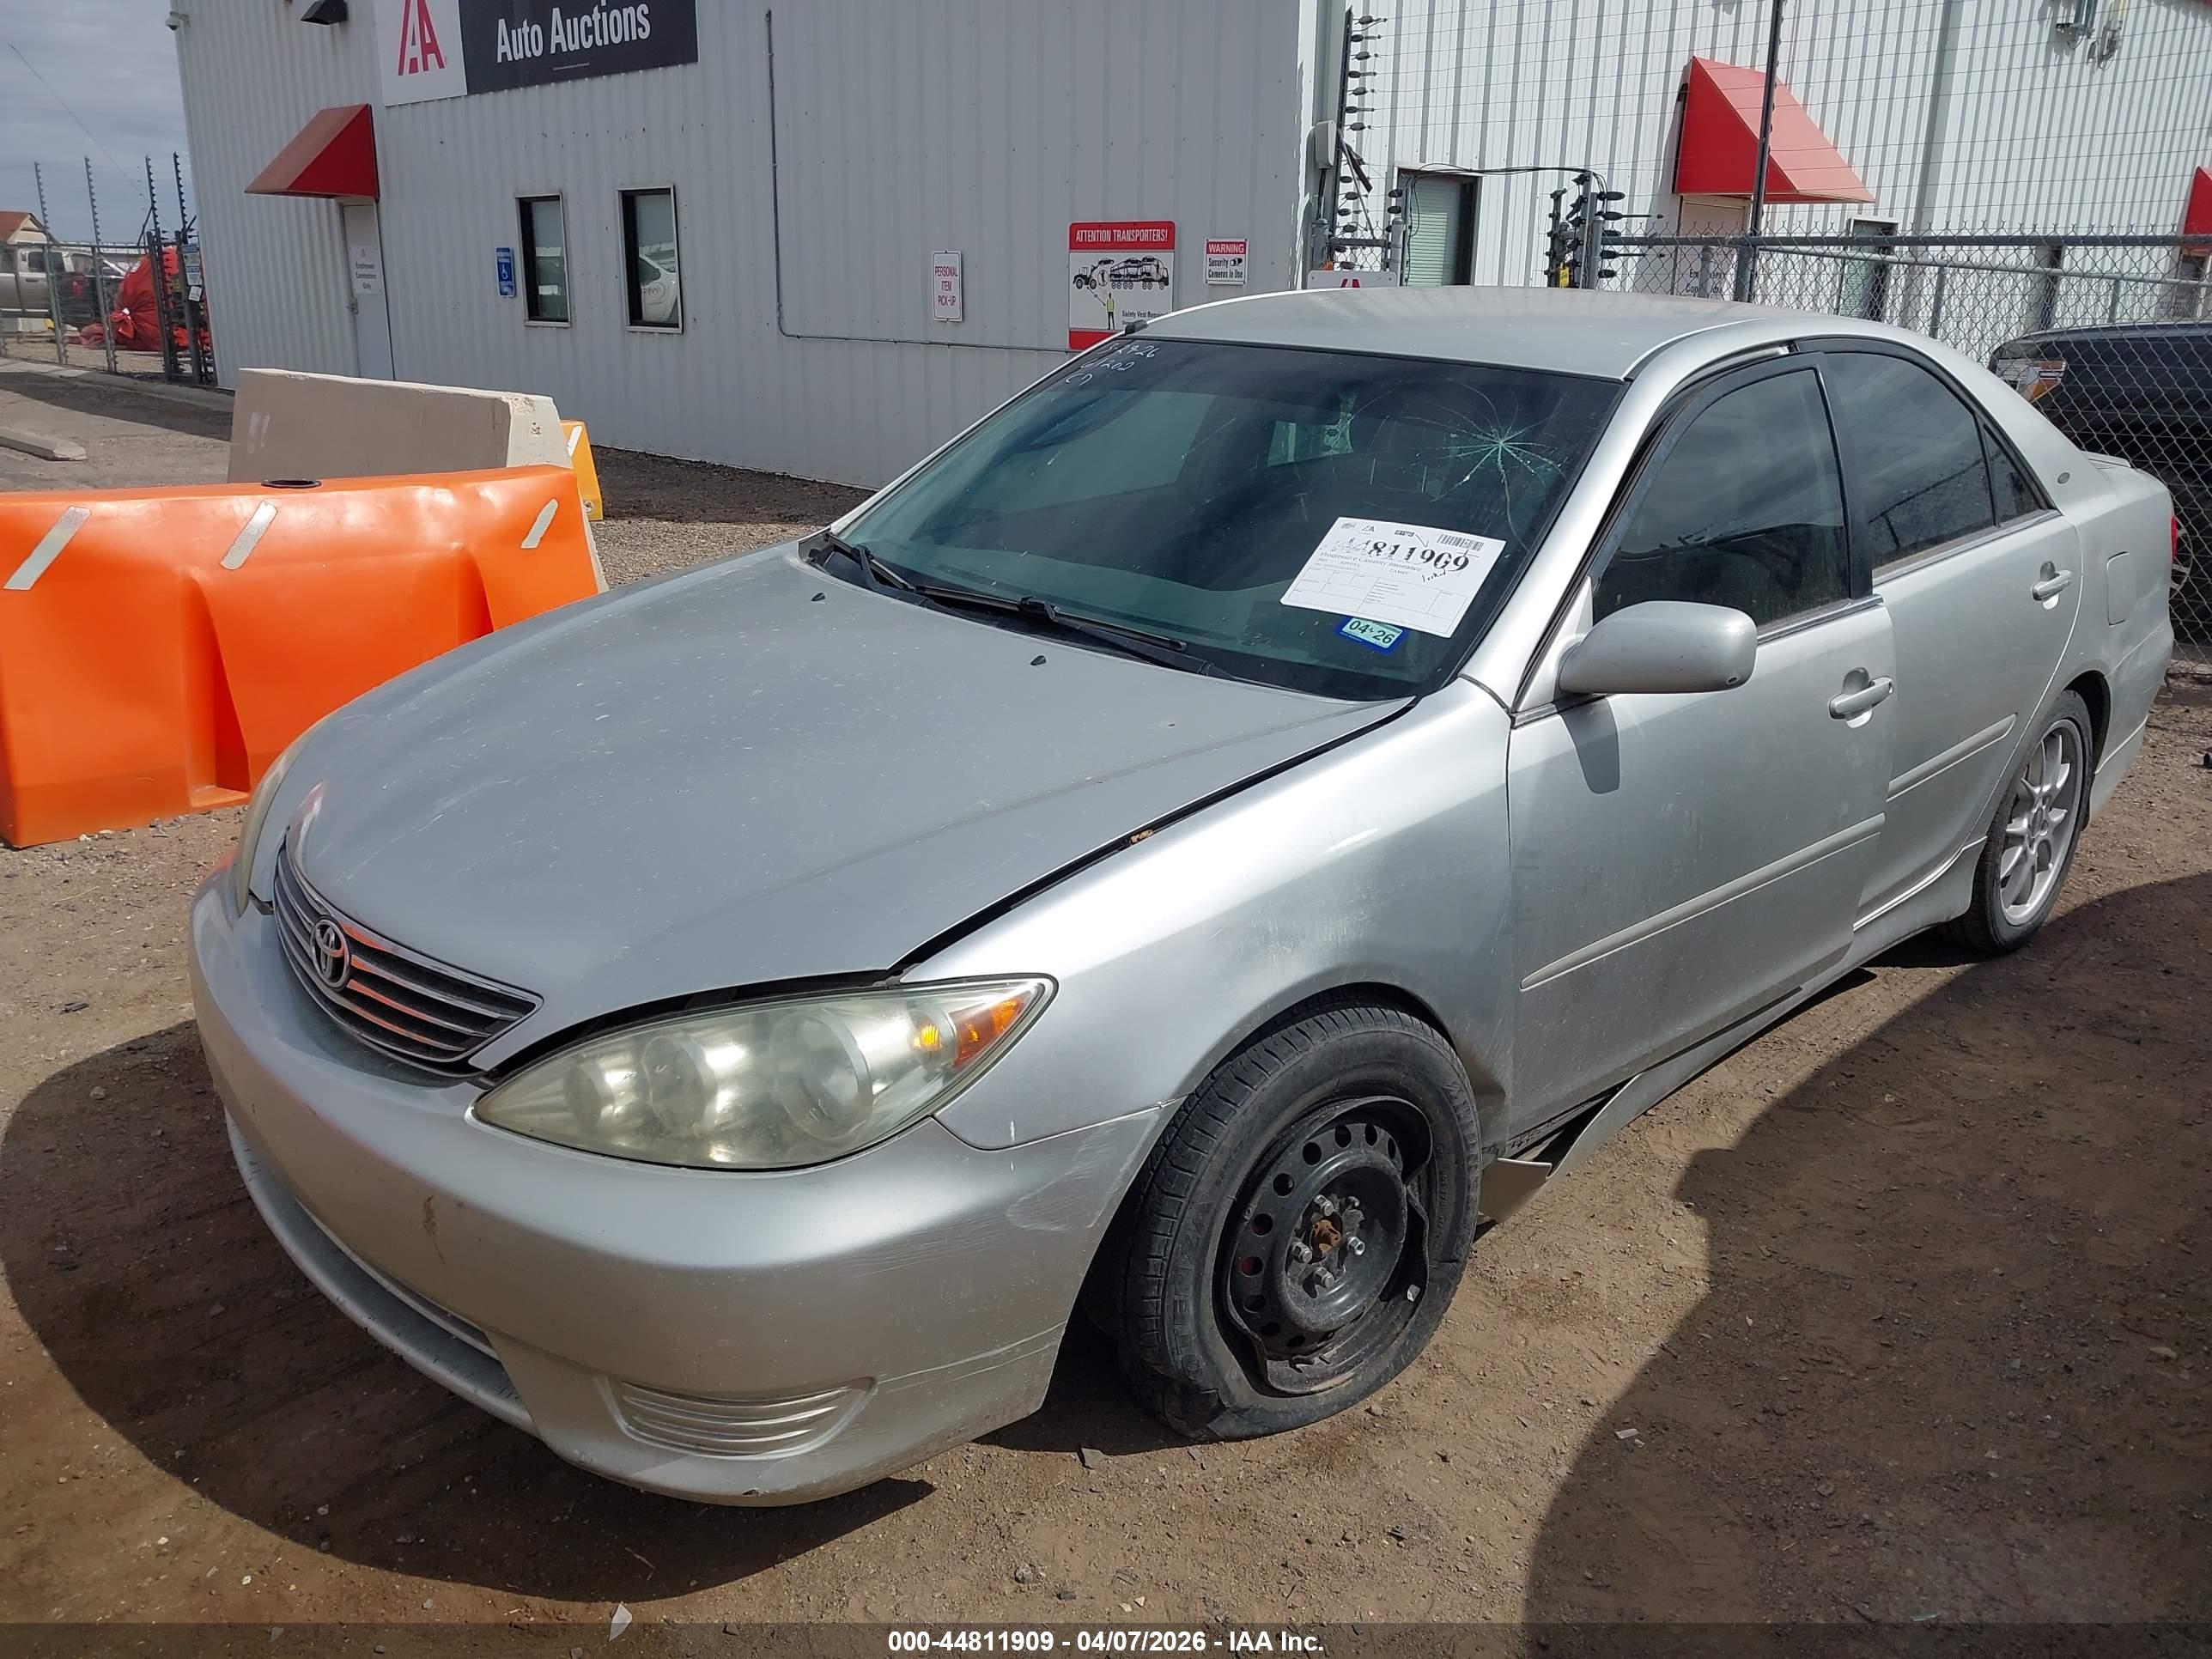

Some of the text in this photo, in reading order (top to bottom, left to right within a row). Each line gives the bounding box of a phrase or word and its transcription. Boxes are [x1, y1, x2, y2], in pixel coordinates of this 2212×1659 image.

[496, 0, 652, 64] Auto Auctions
[1075, 228, 1168, 242] ATTENTION TRANSPORTERS!
[1208, 243, 1244, 253] WARNING
[1208, 258, 1229, 268] Security
[934, 265, 958, 276] PERSONAL
[1208, 269, 1228, 278] Cameras
[941, 281, 952, 291] ITEM
[938, 295, 957, 307] PICK-UP
[1121, 310, 1136, 319] Safety
[1349, 620, 1370, 634] 04
[1372, 629, 1395, 644] 26
